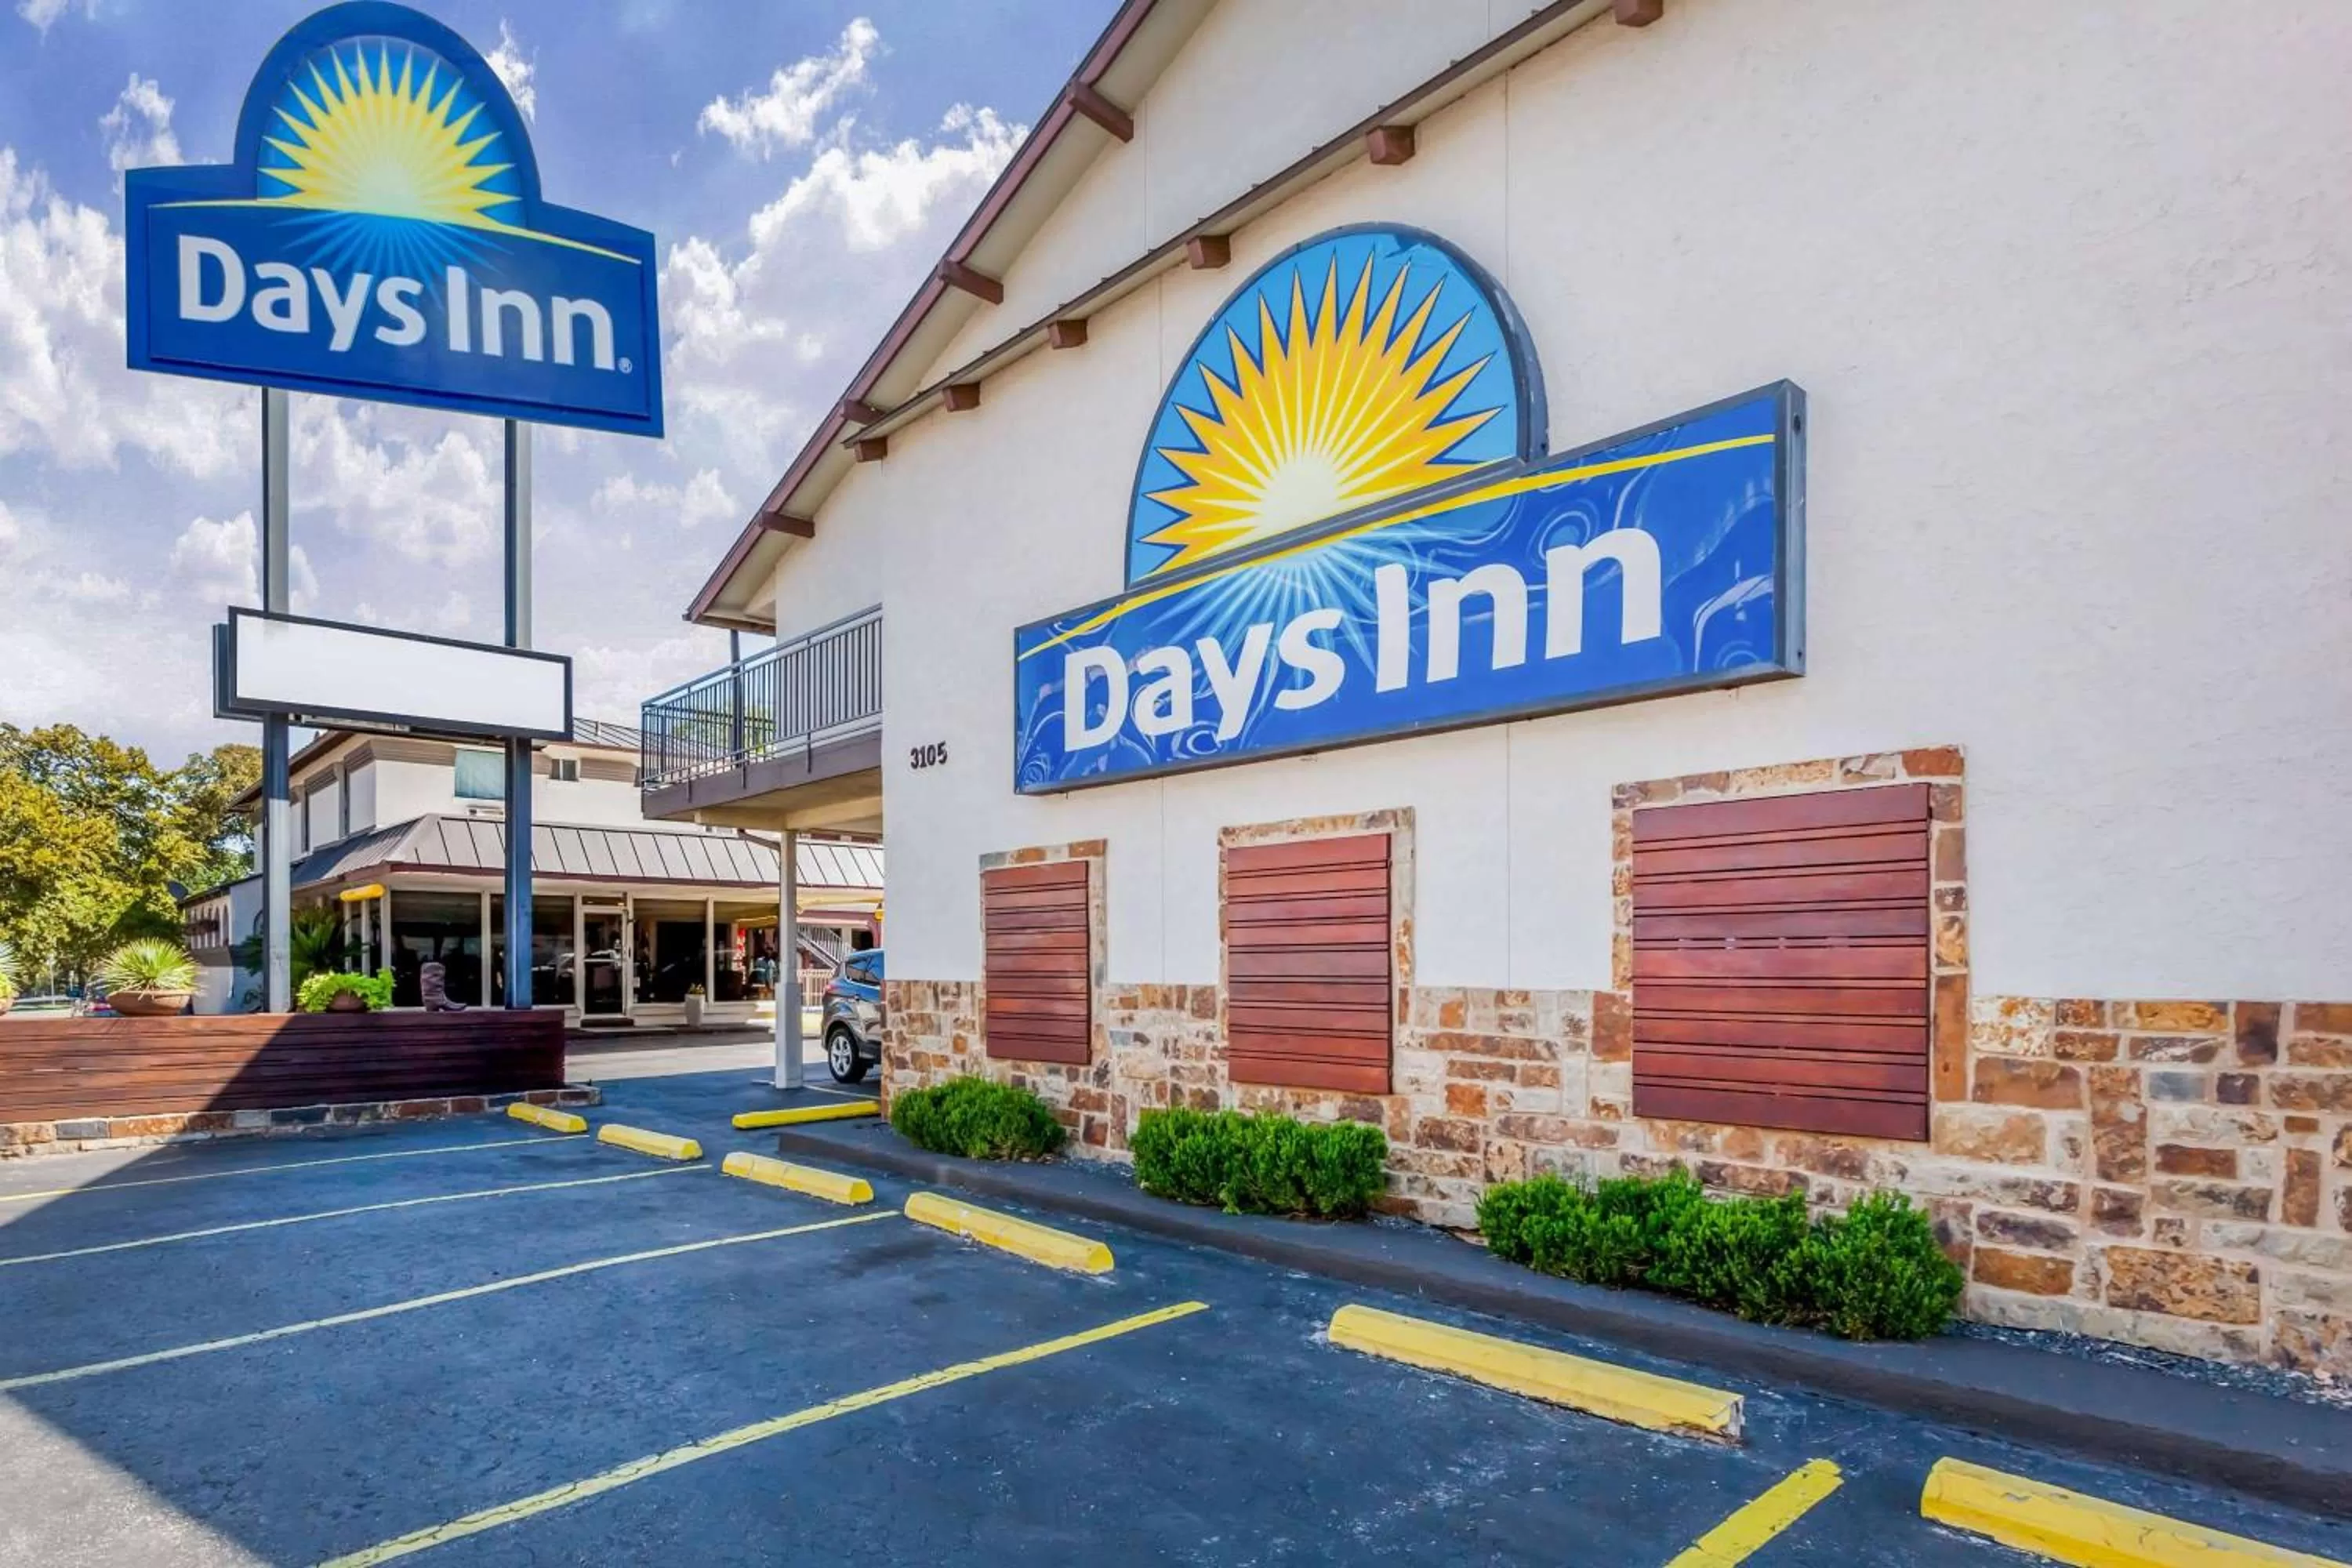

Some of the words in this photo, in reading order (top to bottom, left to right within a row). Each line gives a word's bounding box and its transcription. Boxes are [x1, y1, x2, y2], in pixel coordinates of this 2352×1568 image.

[179, 234, 426, 351] Days
[447, 266, 615, 370] Inn
[1064, 608, 1345, 751] Days
[1374, 528, 1661, 692] Inn
[910, 740, 948, 769] 3105
